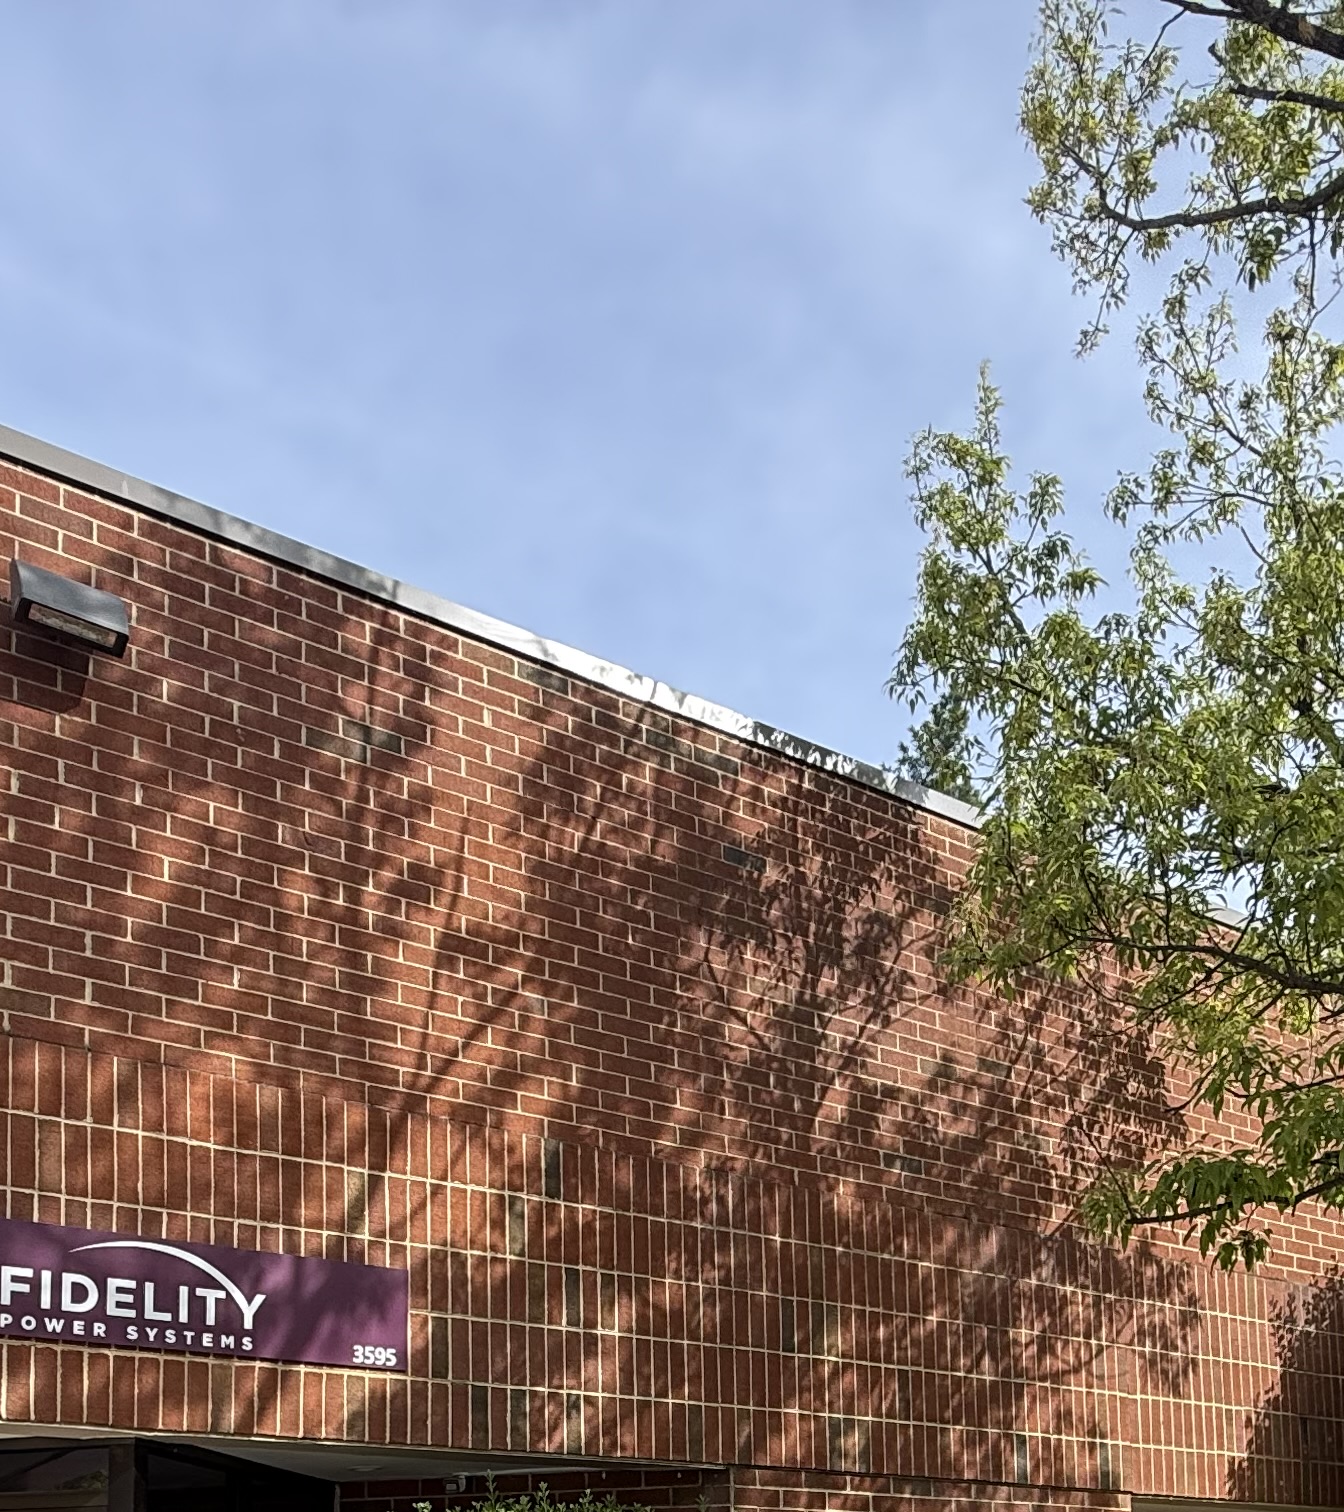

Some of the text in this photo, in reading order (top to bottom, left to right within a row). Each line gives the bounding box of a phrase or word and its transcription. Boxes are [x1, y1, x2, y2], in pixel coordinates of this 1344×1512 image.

[0, 1262, 267, 1330] FIDELITY
[0, 1313, 253, 1351] POWER SYSTEMS
[352, 1345, 397, 1367] 3595
